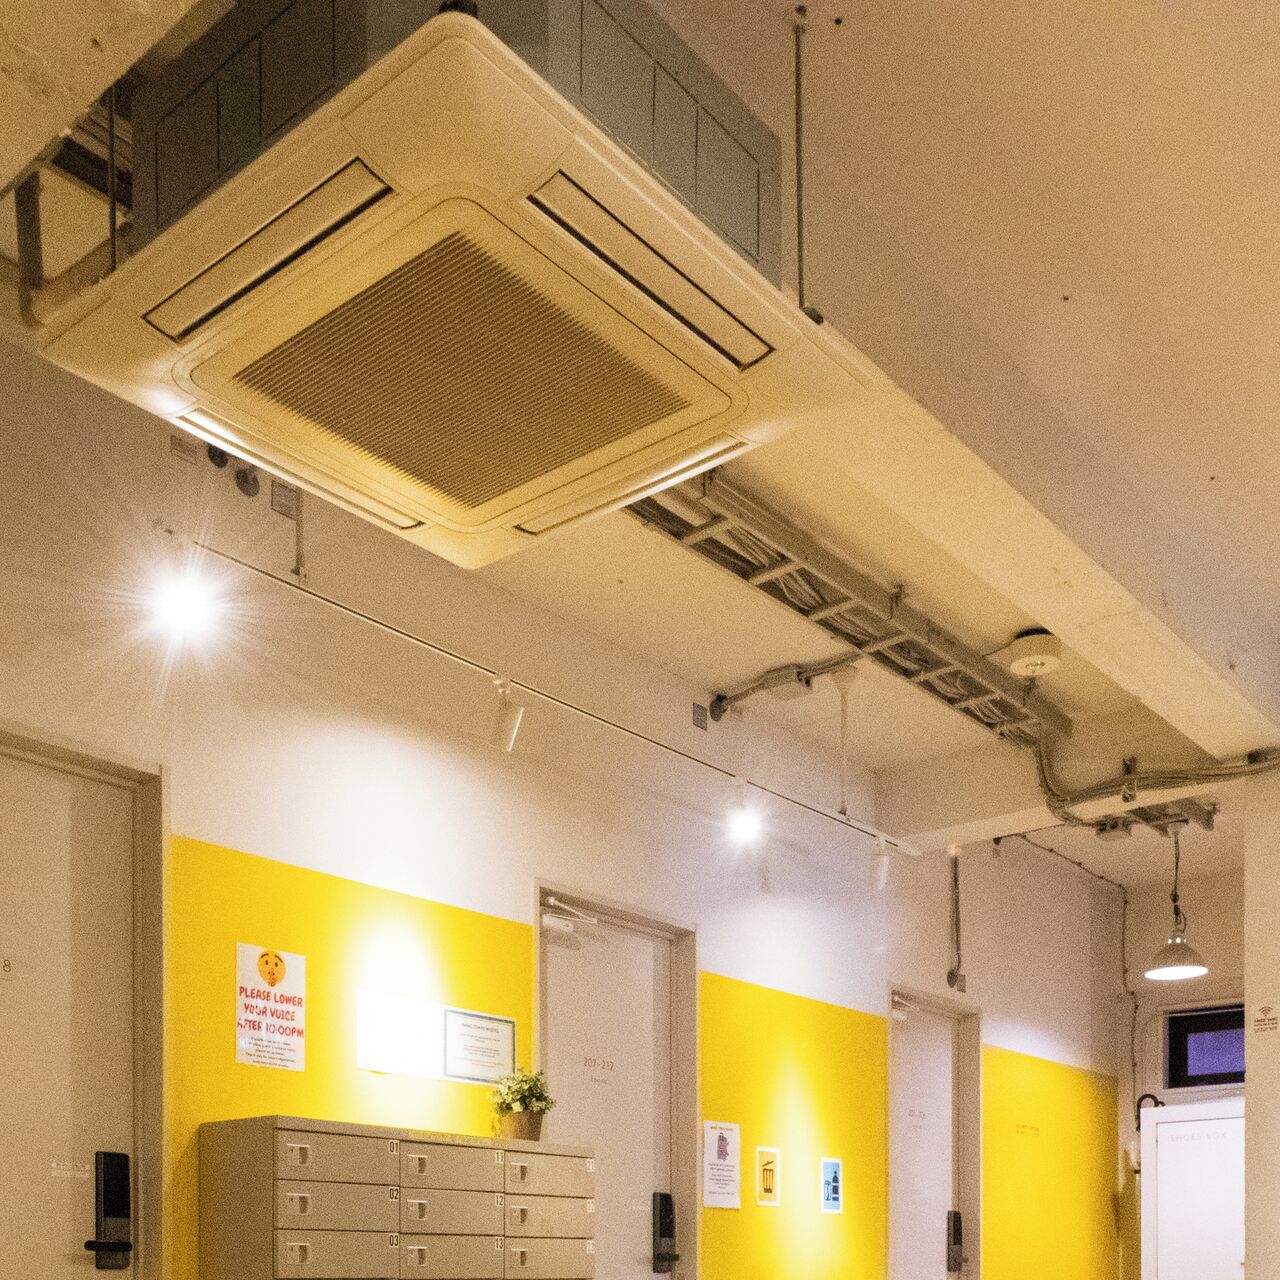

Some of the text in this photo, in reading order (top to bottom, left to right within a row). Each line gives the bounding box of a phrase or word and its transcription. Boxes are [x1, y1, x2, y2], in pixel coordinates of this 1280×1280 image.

[239, 986, 303, 1008] PLEASE LOWER
[243, 1002, 296, 1022] YOUR VOICE
[236, 1017, 304, 1038] AFTER 10:00PM
[389, 1142, 399, 1152] 01
[495, 1151, 504, 1162] 11
[389, 1188, 399, 1199] 02
[495, 1195, 504, 1205] 12
[389, 1235, 399, 1246] 03
[495, 1238, 504, 1249] 13
